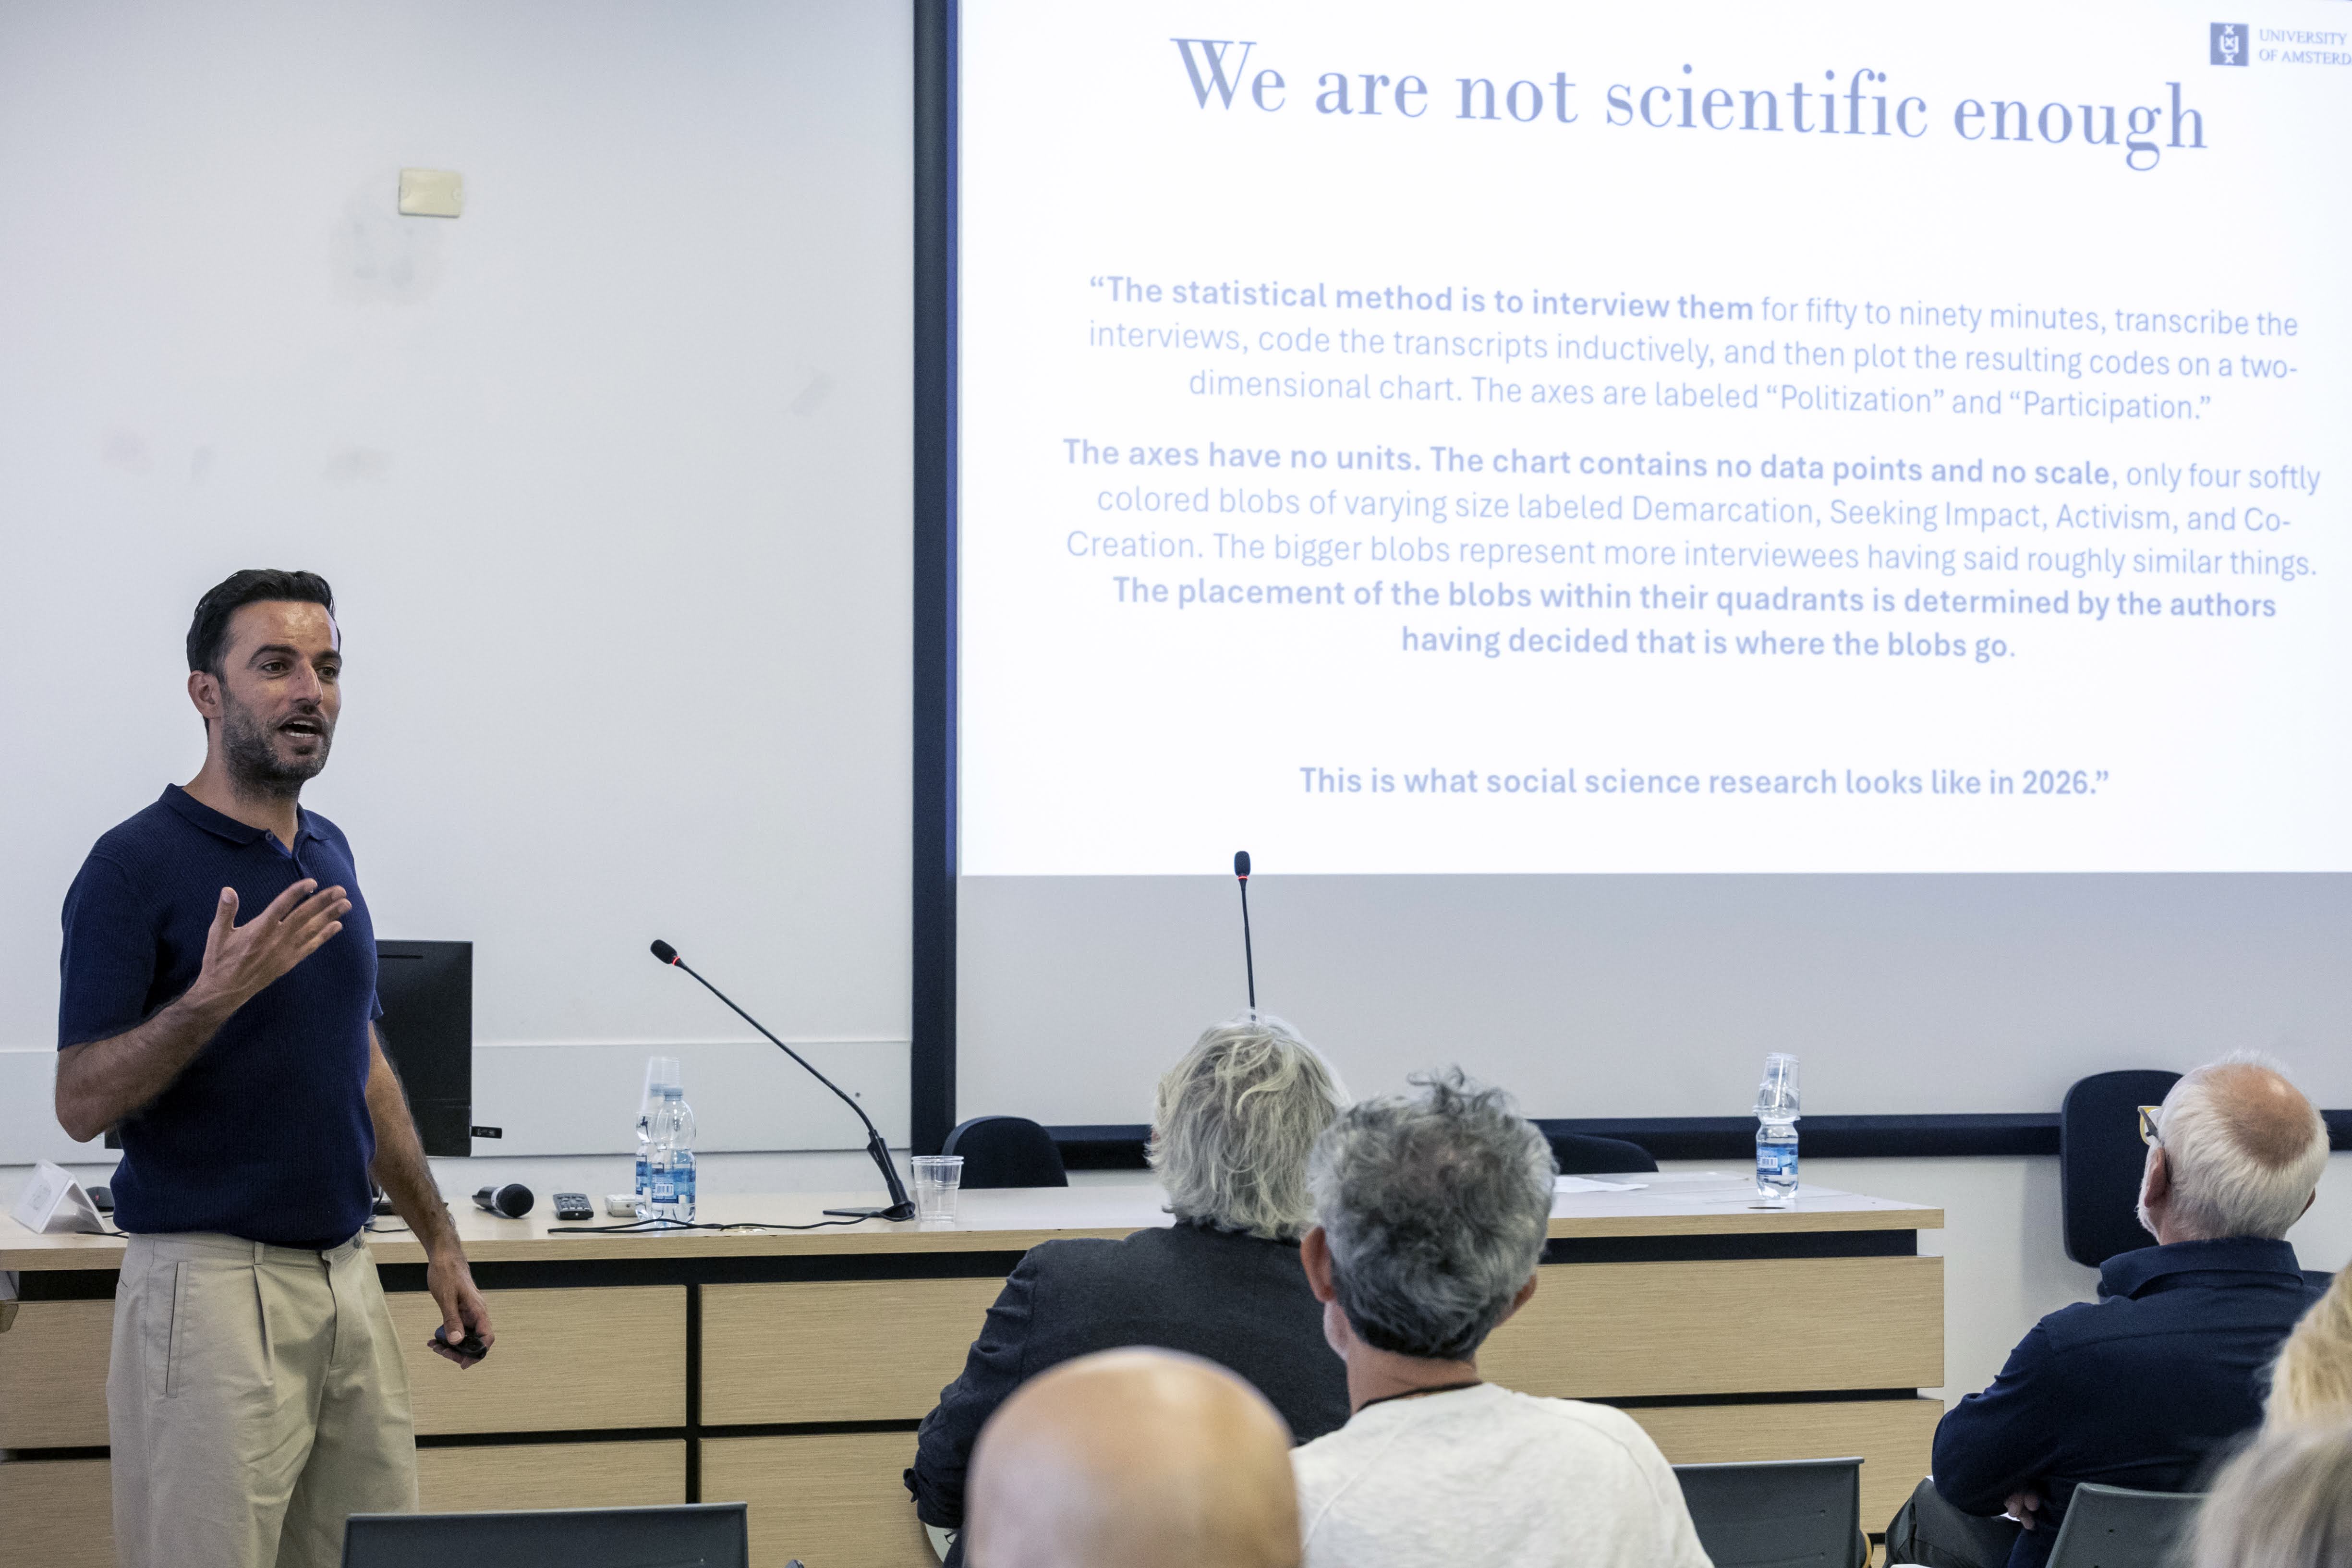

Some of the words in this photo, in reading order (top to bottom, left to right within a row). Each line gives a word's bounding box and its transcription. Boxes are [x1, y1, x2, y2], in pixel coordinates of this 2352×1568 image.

[2259, 28, 2348, 46] UNIVERSITY
[2259, 49, 2278, 61] OF
[2282, 50, 2352, 65] AMSTERD
[1169, 38, 1286, 112] We
[1316, 73, 1428, 118] are
[1455, 72, 1578, 123] not
[1606, 63, 1928, 138] scientific
[1953, 82, 2208, 171] enough
[1090, 275, 1163, 303] “The
[1173, 280, 1327, 307] statistical
[1336, 284, 1452, 311] method
[1463, 286, 1486, 312] is
[1493, 291, 1523, 314] to
[1533, 288, 1670, 318] interview
[1677, 294, 1753, 320] them
[1761, 296, 1798, 321] for
[1806, 297, 1857, 330] fifty
[1865, 301, 1891, 325] to
[1900, 300, 1982, 333] ninety
[1990, 304, 2106, 335] minutes,
[2115, 309, 2249, 335] transcribe
[2256, 312, 2297, 336] the
[1091, 320, 1248, 354] interviews,
[1259, 327, 1329, 352] code
[1339, 328, 1384, 353] the
[1393, 331, 1548, 364] transcripts
[1558, 333, 1714, 369] inductively,
[1725, 340, 1774, 365] and
[1783, 340, 1844, 366] then
[1855, 343, 1905, 374] plot
[1914, 344, 1956, 369] the
[1966, 347, 2082, 379] resulting
[2090, 350, 2170, 375] codes
[2178, 357, 2209, 377] on
[2218, 358, 2232, 377] a
[2240, 355, 2297, 378] two-
[1190, 369, 1370, 399] dimensional
[1380, 375, 1461, 401] chart.
[1471, 377, 1521, 402] The
[1531, 384, 1594, 404] axes
[1603, 385, 1646, 405] are
[1656, 381, 1758, 408] labeled
[1767, 384, 1944, 413] “Politization”
[1952, 390, 2001, 414] and
[2010, 390, 2211, 423] “Participation.”
[1063, 438, 1119, 465] The
[1129, 447, 1199, 466] axes
[1210, 441, 1281, 468] have
[1291, 450, 1327, 469] no
[1337, 445, 1420, 471] units.
[1430, 446, 1483, 472] The
[1493, 448, 1571, 474] chart
[1579, 451, 1707, 476] contains
[1717, 459, 1752, 478] no
[1760, 453, 1823, 479] data
[1833, 455, 1922, 486] points
[1931, 458, 1983, 483] and
[1992, 465, 2026, 484] no
[2035, 461, 2117, 489] scale,
[2127, 462, 2182, 493] only
[2189, 462, 2242, 488] four
[2249, 464, 2320, 496] softly
[1098, 486, 1209, 512] colored
[1220, 488, 1299, 514] blobs
[1310, 489, 1337, 515] of
[1345, 490, 1447, 523] varying
[1456, 492, 1509, 518] size
[1519, 493, 1622, 520] labeled
[1633, 495, 1821, 527] Demarcation,
[1831, 499, 1938, 532] Seeking
[1946, 501, 2048, 533] Impact,
[2056, 503, 2178, 534] Activism,
[2188, 507, 2235, 531] and
[2244, 507, 2291, 532] Co-
[1067, 531, 1202, 558] Creation.
[1213, 533, 1264, 559] The
[1275, 534, 1362, 567] bigger
[1371, 535, 1450, 562] blobs
[1460, 541, 1595, 569] represent
[1605, 546, 1675, 565] more
[1685, 540, 1859, 568] interviewees
[1868, 544, 1956, 576] having
[1964, 546, 2018, 571] said
[2028, 547, 2126, 579] roughly
[2133, 548, 2223, 574] similar
[2230, 549, 2316, 582] things.
[1113, 576, 1168, 602] The
[1179, 577, 1345, 610] placement
[1354, 580, 1383, 605] of
[1391, 581, 1440, 606] the
[1449, 581, 1532, 607] blobs
[1540, 583, 1631, 608] within
[1639, 584, 1709, 609] their
[1717, 586, 1864, 617] quadrants
[1873, 587, 1895, 612] is
[1904, 588, 2069, 614] determined
[2078, 590, 2110, 621] by
[2117, 591, 2162, 616] the
[2170, 592, 2276, 617] authors
[1403, 625, 1501, 658] having
[1508, 627, 1627, 653] decided
[1637, 629, 1696, 654] that
[1705, 629, 1727, 654] is
[1735, 630, 1825, 655] where
[1832, 631, 1879, 656] the
[1888, 631, 1966, 657] blobs
[1975, 637, 2015, 664] go.
[1299, 767, 1362, 793] This
[1371, 767, 1395, 793] is
[1404, 767, 1478, 793] what
[1487, 768, 1577, 793] social
[1585, 768, 1700, 793] science
[1709, 768, 1836, 794] research
[1846, 769, 1923, 794] looks
[1932, 769, 1981, 794] like
[1990, 769, 2013, 794] in
[2022, 769, 2109, 795] 2026.”
